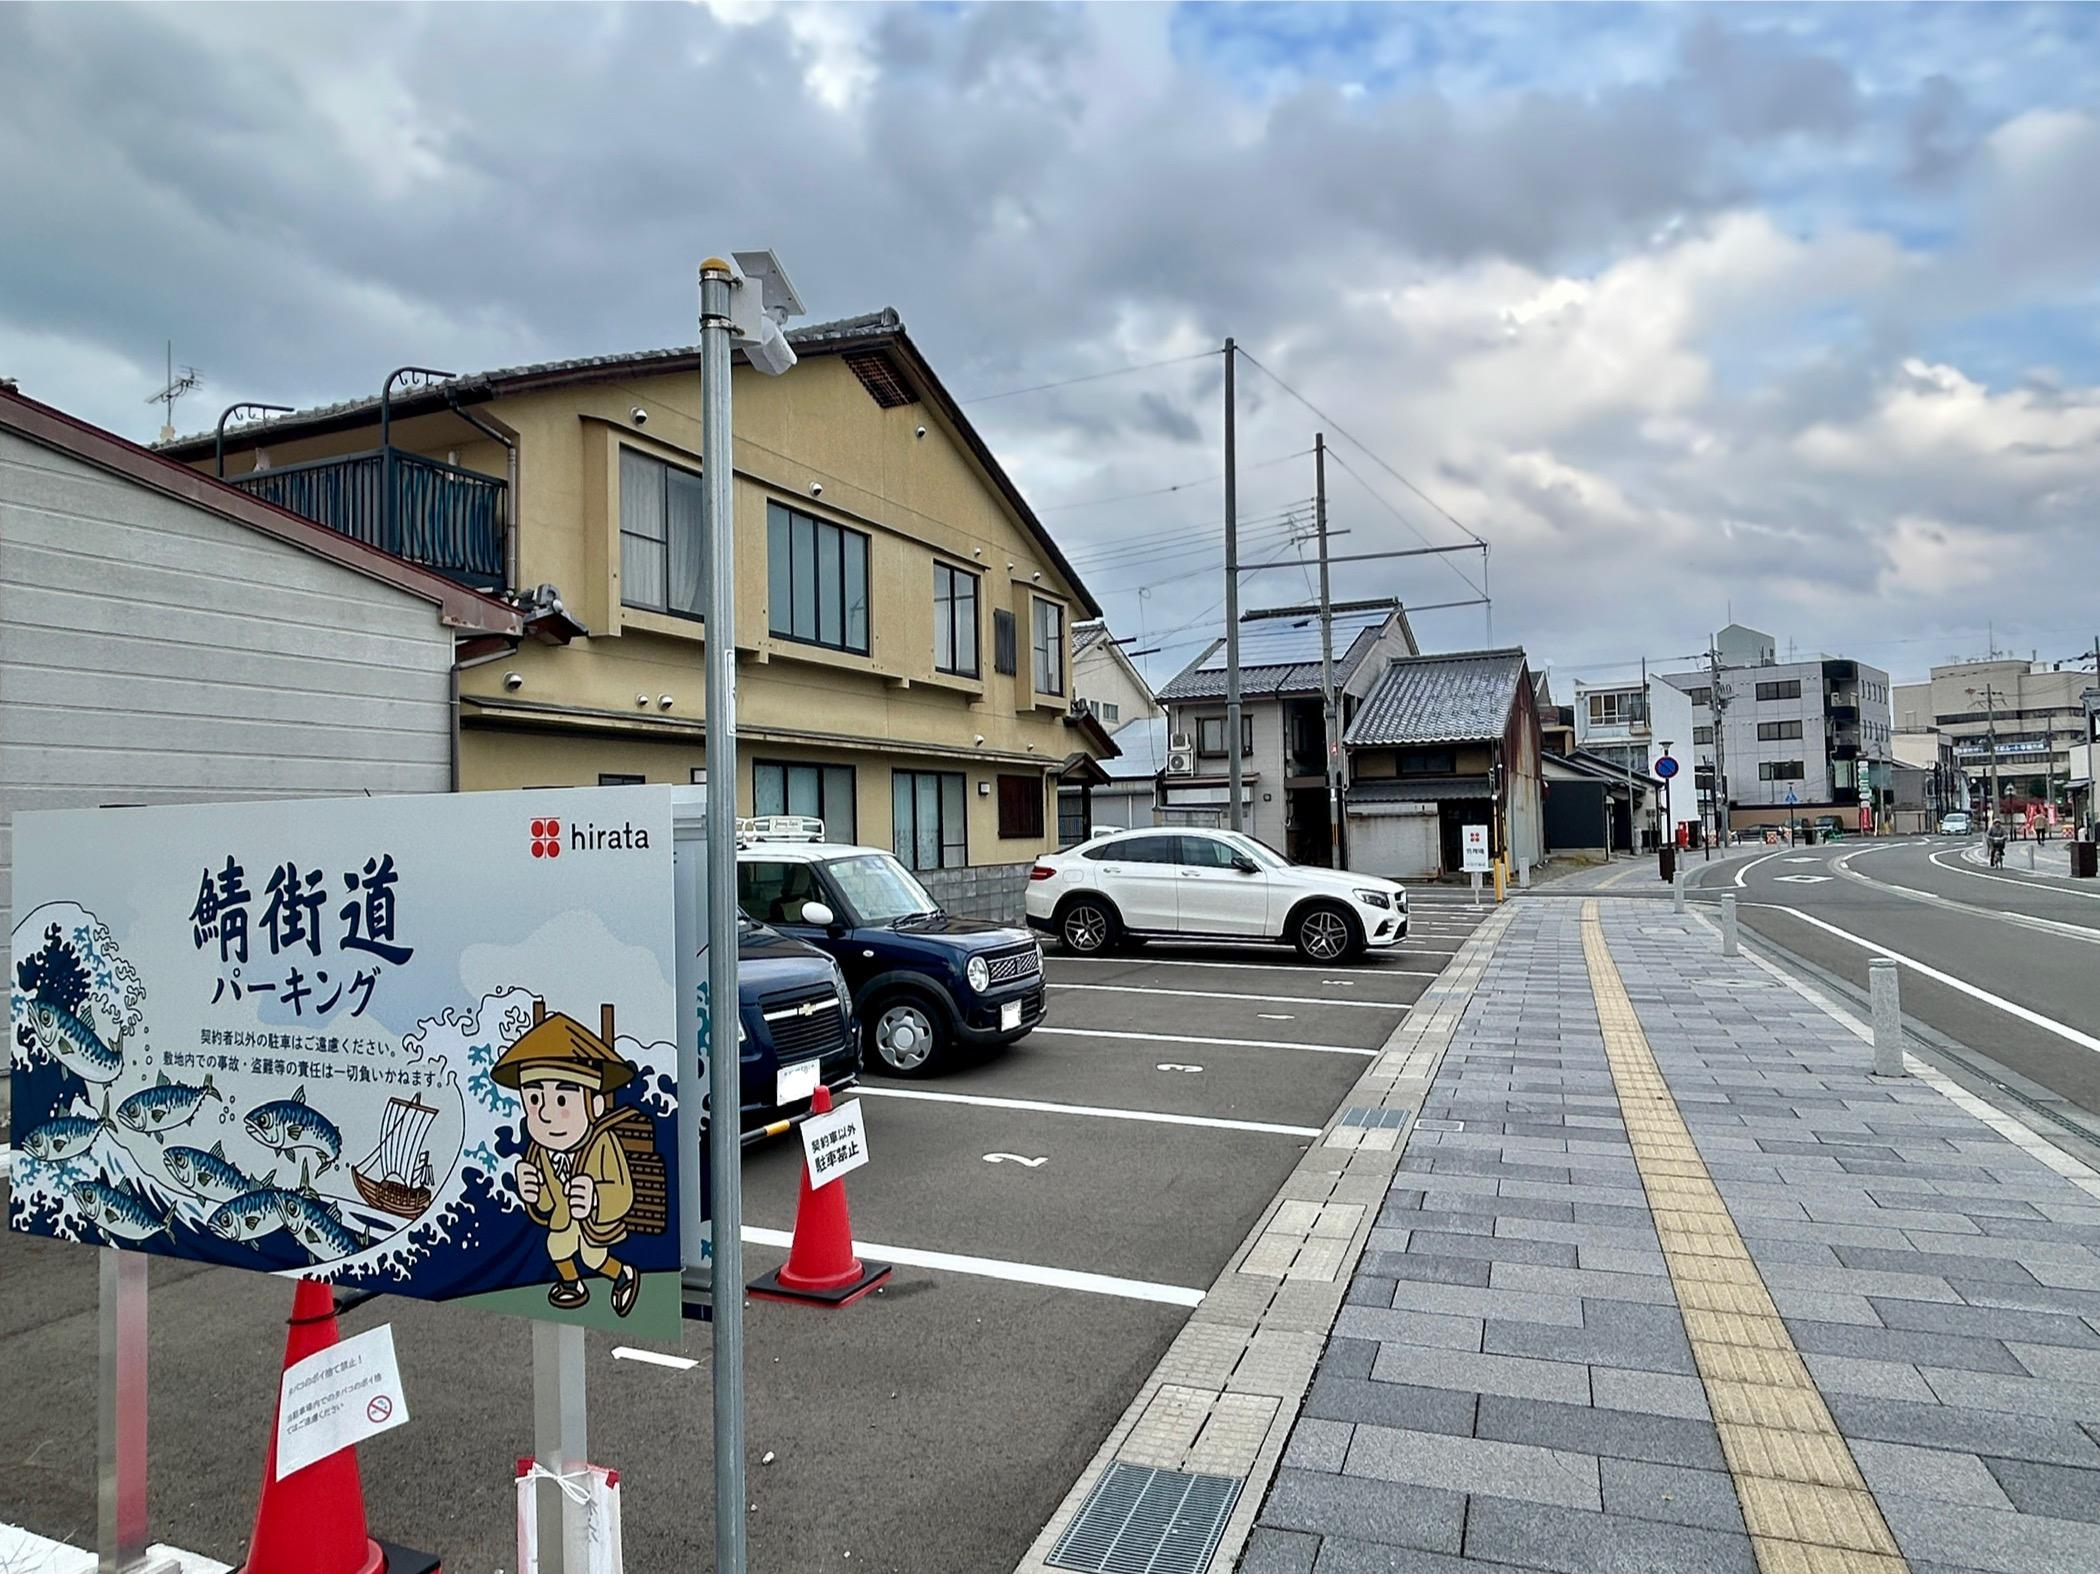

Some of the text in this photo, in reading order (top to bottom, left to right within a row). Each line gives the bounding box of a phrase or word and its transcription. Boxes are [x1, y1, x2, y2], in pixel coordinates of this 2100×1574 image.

[571, 821, 650, 850] hirata
[188, 853, 414, 965] 鯖街道
[210, 965, 382, 1017] パーキング
[200, 1028, 396, 1058] 契約者以外の駐車はご遠慮ください。
[162, 1050, 443, 1089] 敷地内での事故・盗難等の責任は一切負いかねます。
[811, 1121, 857, 1154] 契約車以外
[814, 1140, 860, 1173] 駐車禁止
[982, 1152, 1049, 1167] 2
